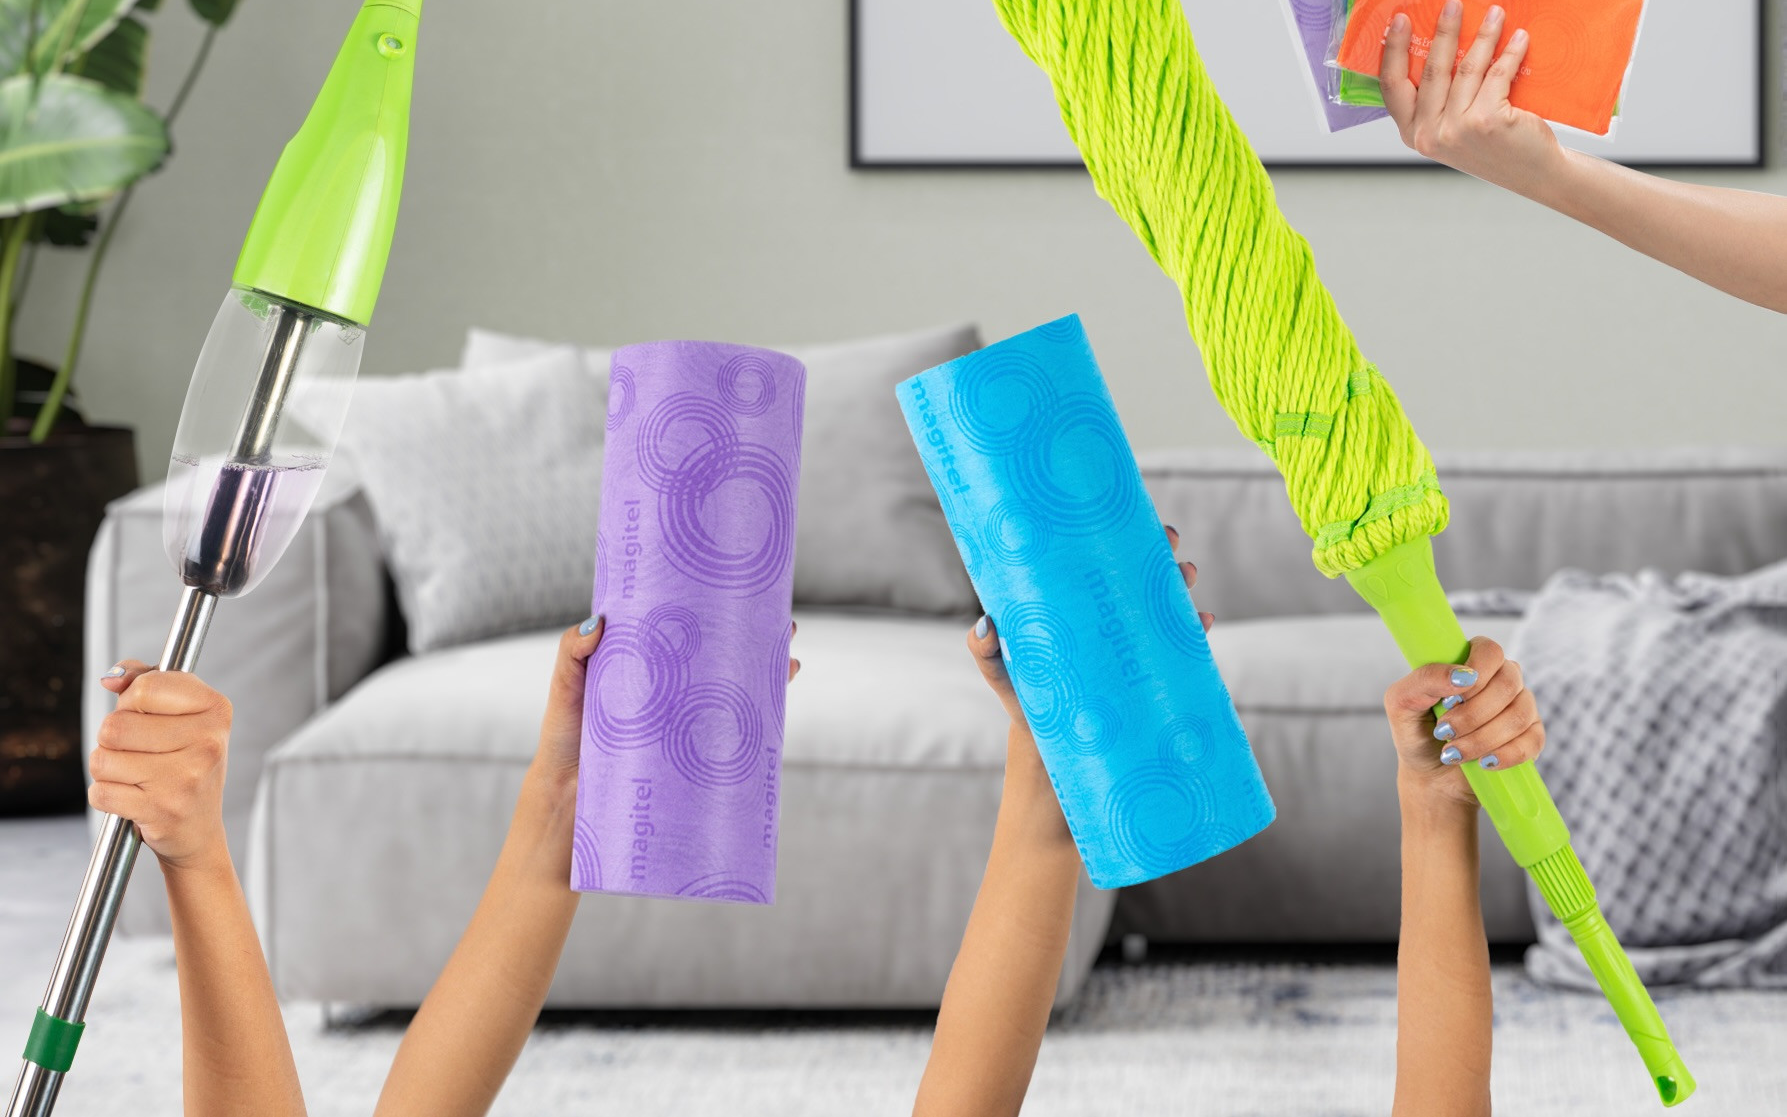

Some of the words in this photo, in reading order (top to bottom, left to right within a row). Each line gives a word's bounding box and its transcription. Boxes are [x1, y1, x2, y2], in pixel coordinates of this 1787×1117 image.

[910, 376, 971, 495] magitel
[622, 500, 642, 599] magitel
[1084, 569, 1153, 687] magitel
[629, 778, 655, 880] magitel
[763, 747, 777, 849] magitel
